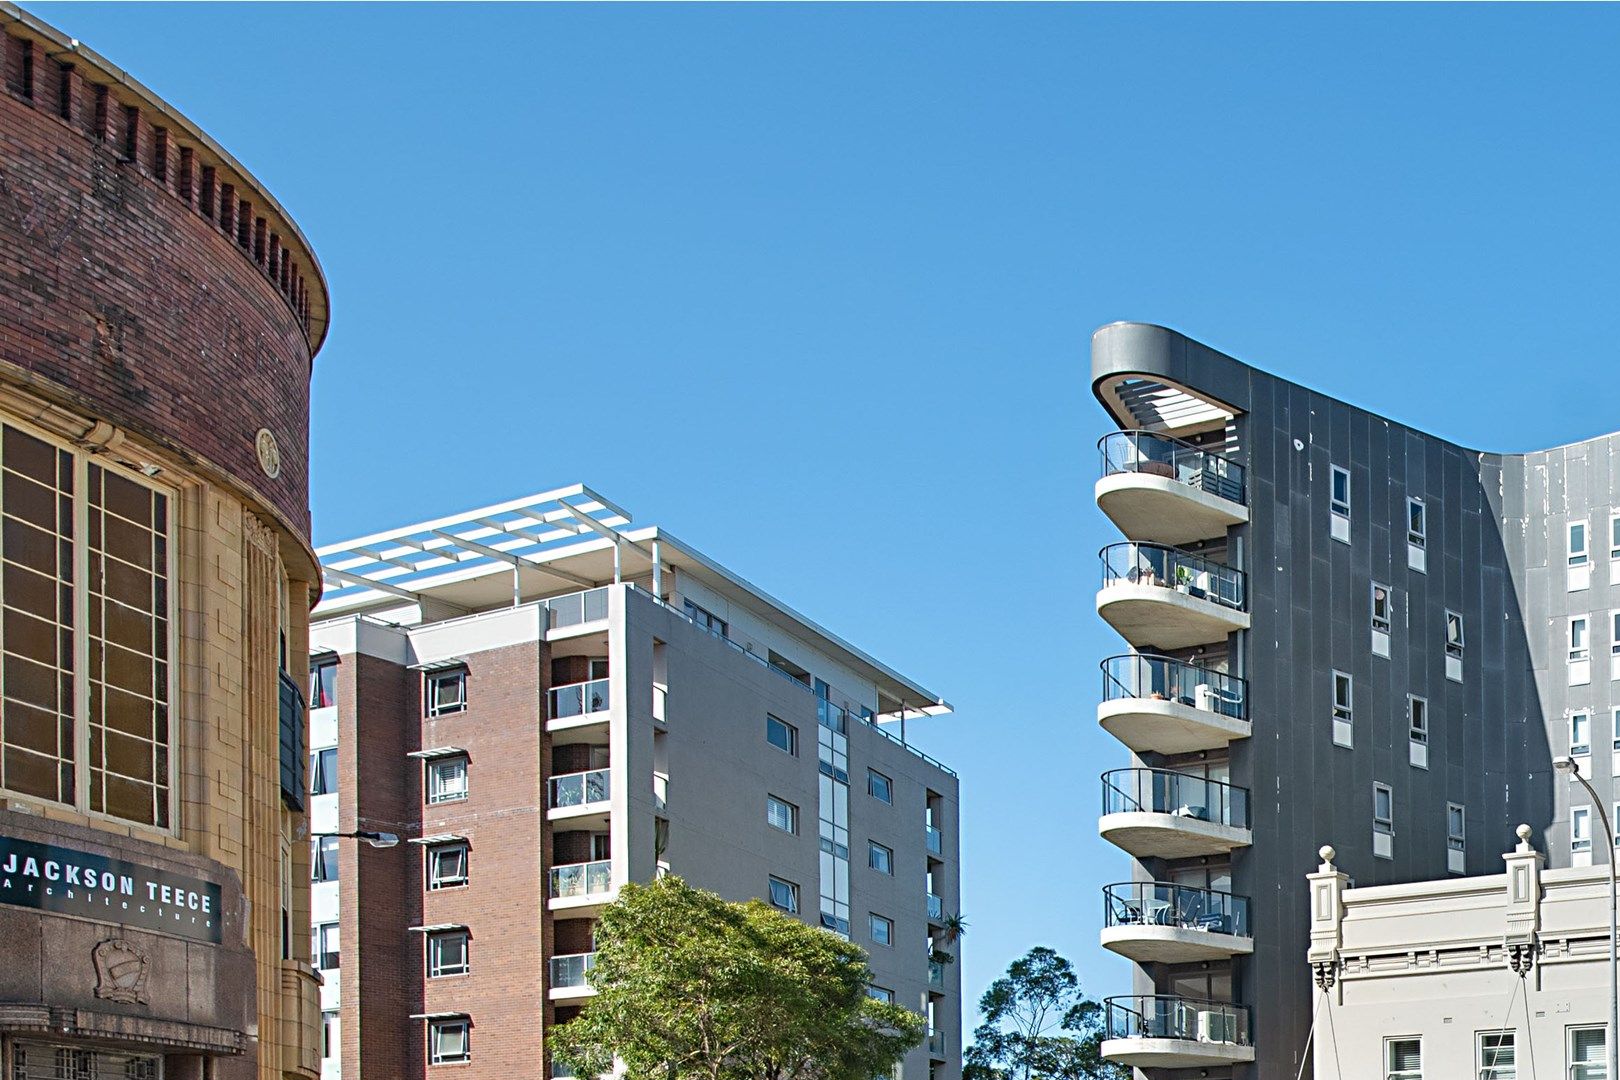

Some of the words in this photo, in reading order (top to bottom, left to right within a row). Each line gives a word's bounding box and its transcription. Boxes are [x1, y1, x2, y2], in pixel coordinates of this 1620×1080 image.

[3, 853, 134, 896] JACKSON
[146, 881, 211, 914] TEECE
[3, 878, 211, 928] Architecture
